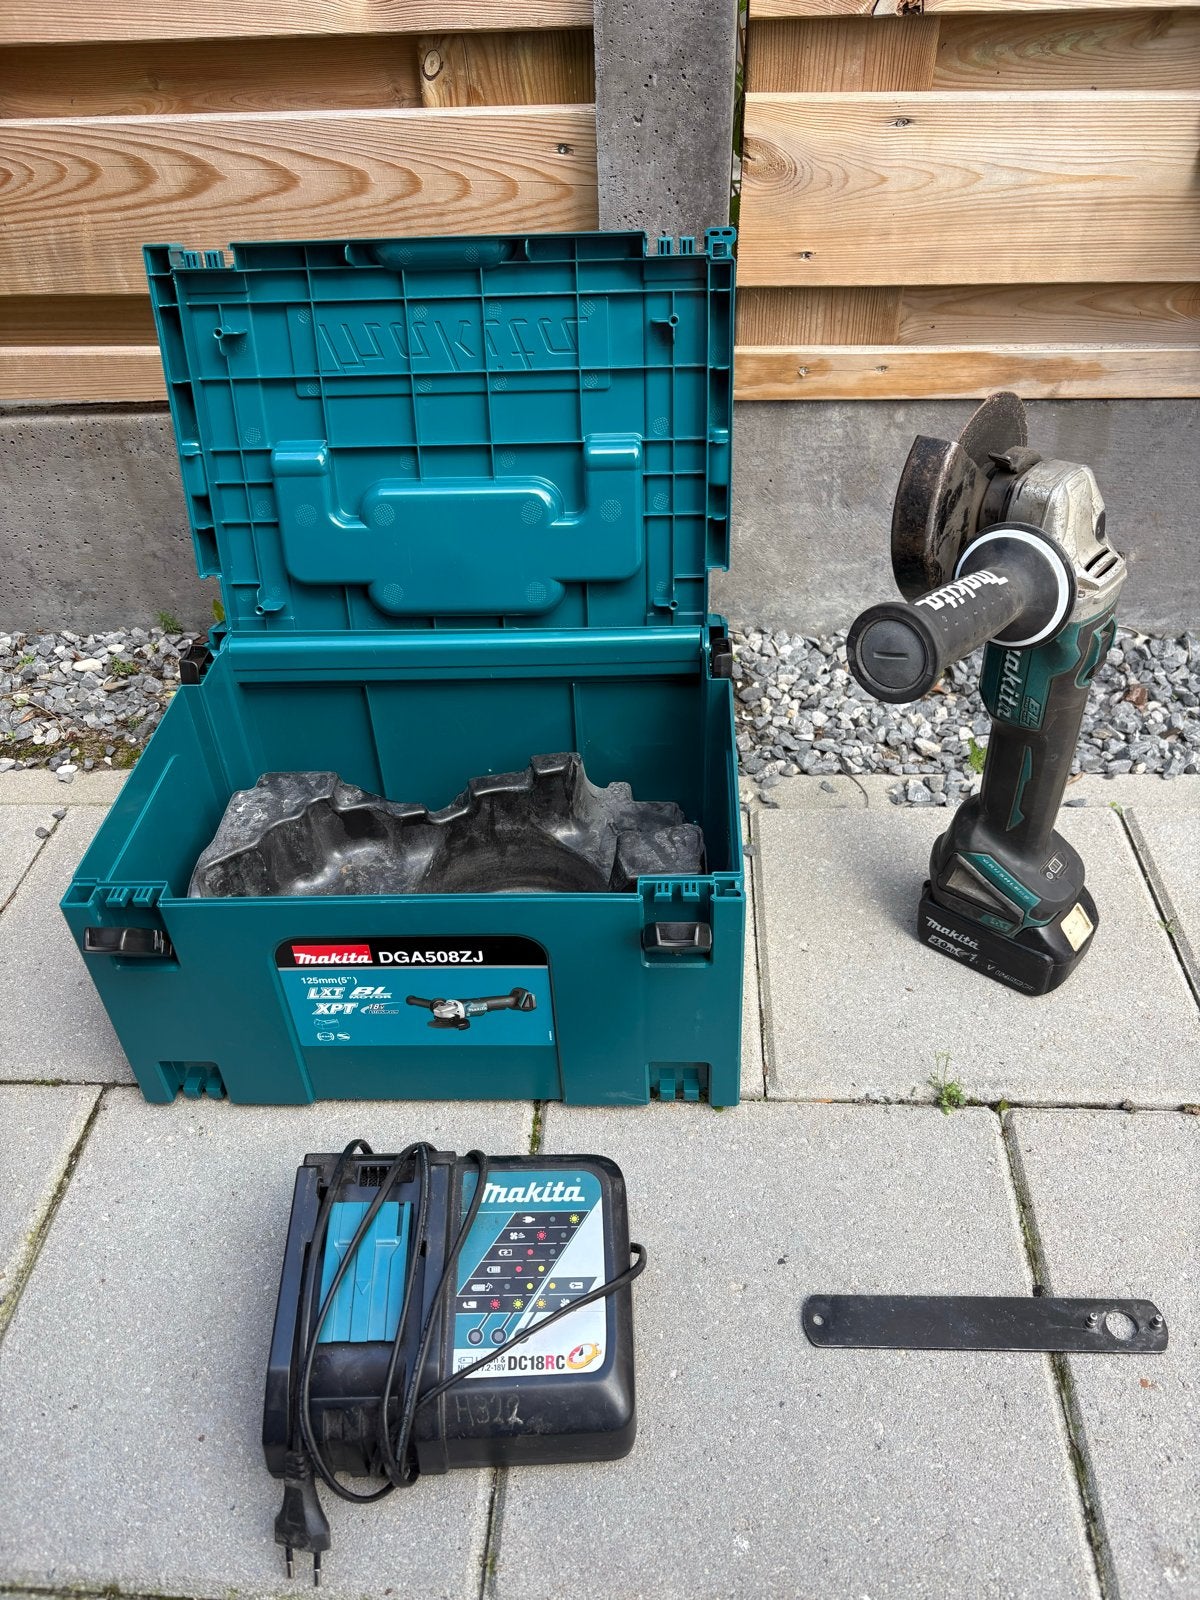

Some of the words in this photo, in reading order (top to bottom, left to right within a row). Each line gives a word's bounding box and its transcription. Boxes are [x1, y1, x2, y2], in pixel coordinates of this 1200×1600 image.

[379, 951, 484, 963] DGA508ZJ
[307, 986, 345, 999] LXT
[312, 1003, 358, 1014] XPT
[507, 1355, 565, 1370] DC18RC
